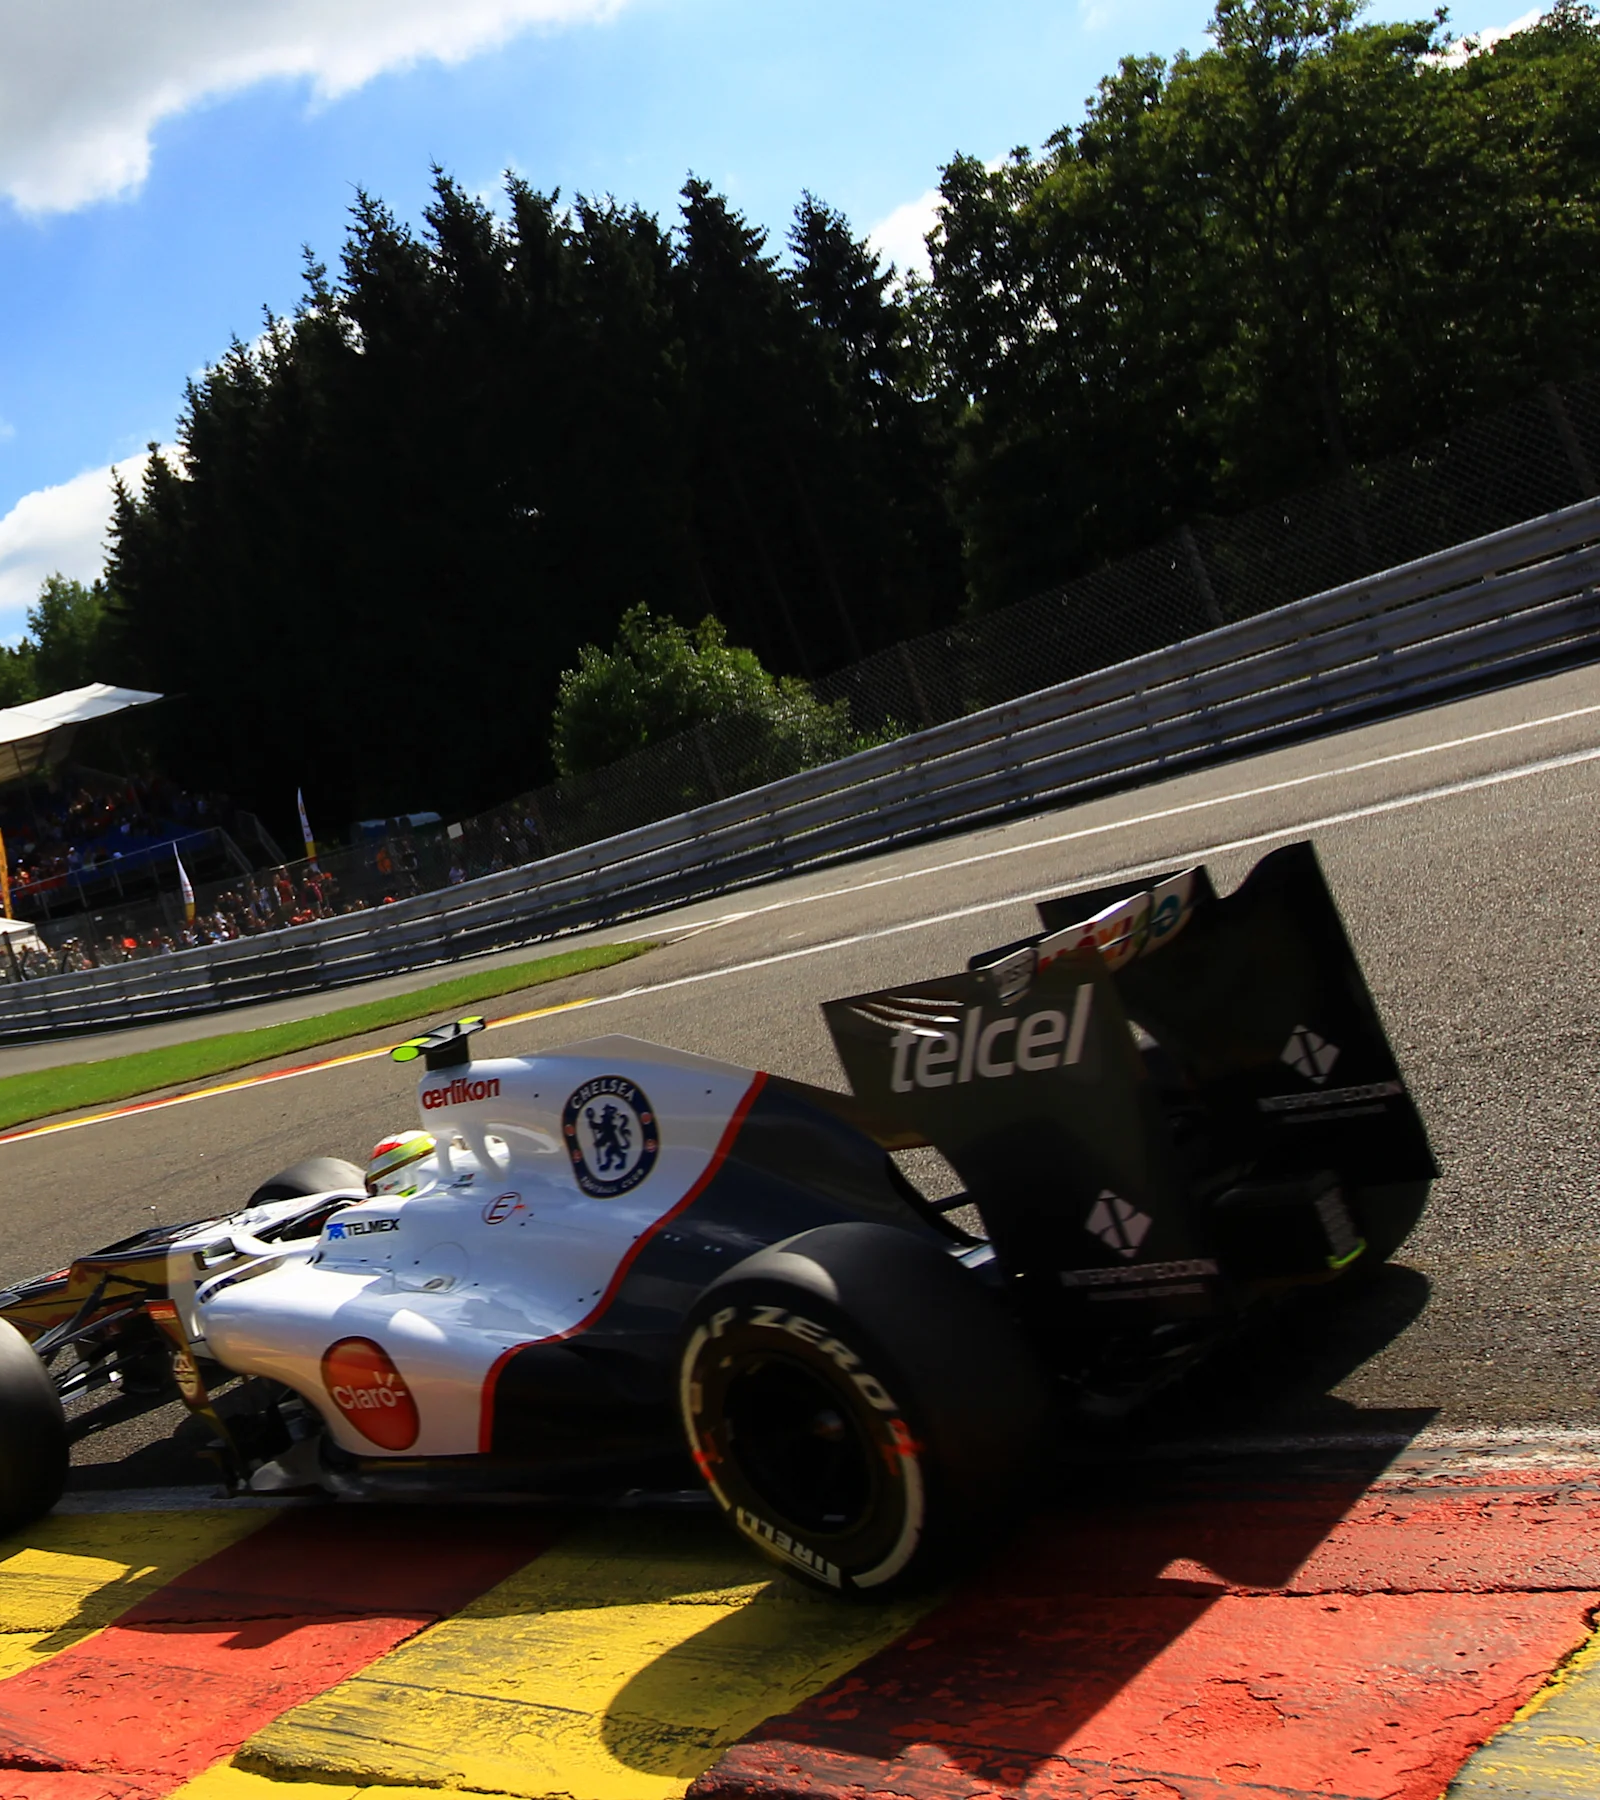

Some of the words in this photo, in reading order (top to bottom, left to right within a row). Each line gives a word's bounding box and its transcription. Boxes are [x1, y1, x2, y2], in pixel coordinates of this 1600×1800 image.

[890, 983, 1095, 1094] telcel
[570, 1079, 637, 1109] CHELSEA
[345, 1218, 401, 1236] TELMEX
[708, 1304, 738, 1339] P
[747, 1304, 900, 1412] ZERO
[332, 1383, 398, 1410] Claro
[735, 1504, 843, 1590] PIRELLI
